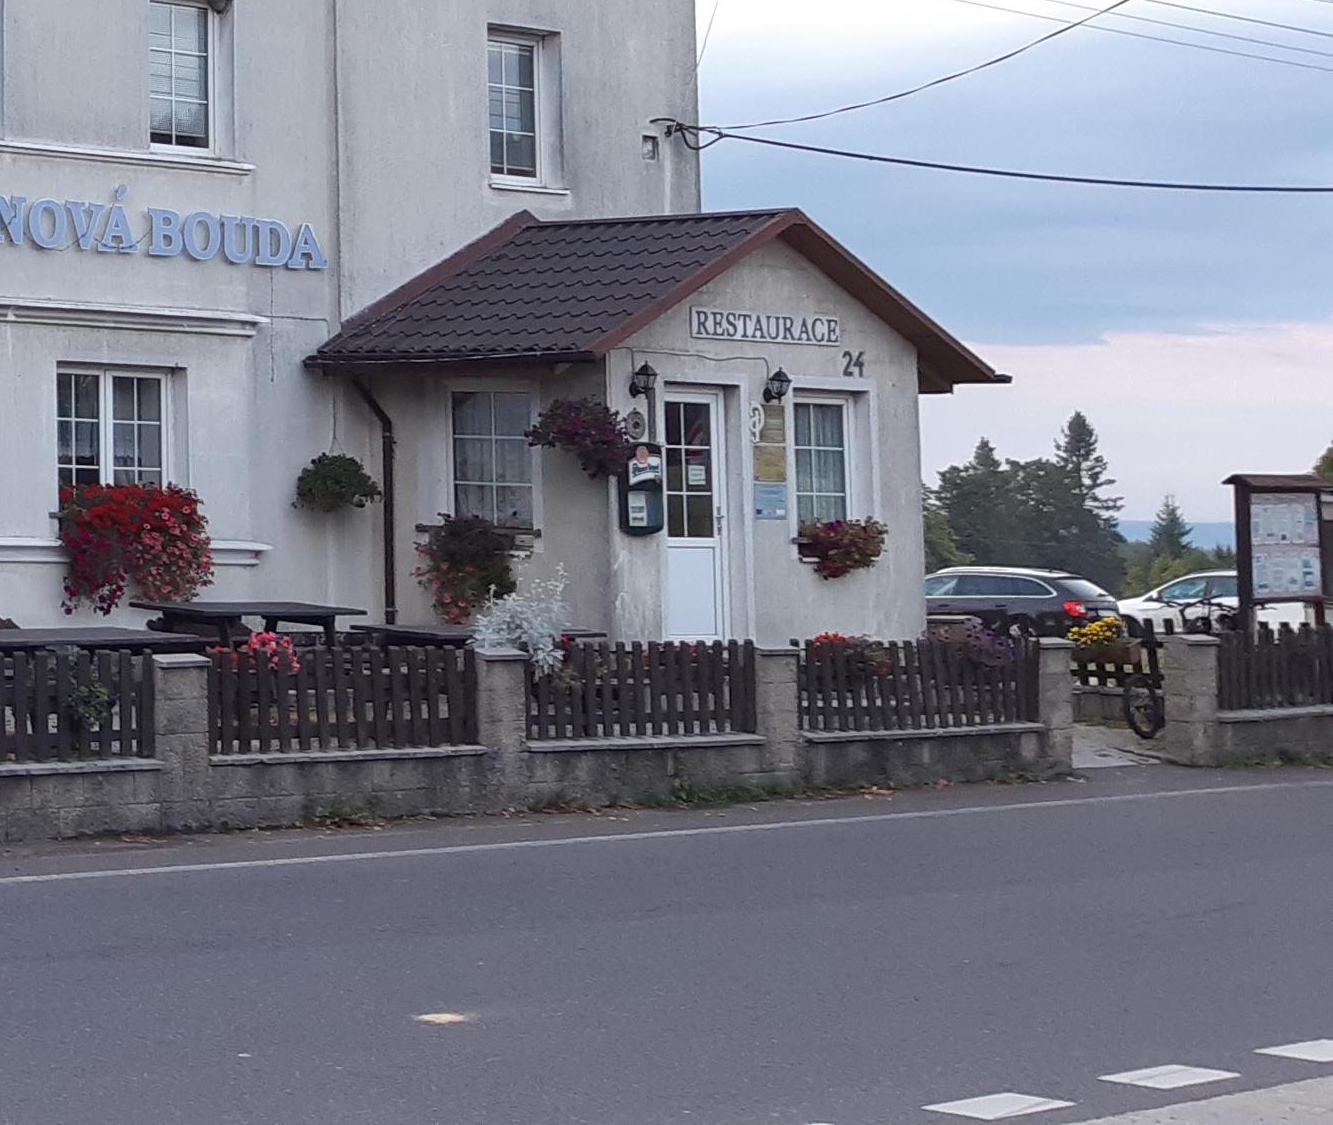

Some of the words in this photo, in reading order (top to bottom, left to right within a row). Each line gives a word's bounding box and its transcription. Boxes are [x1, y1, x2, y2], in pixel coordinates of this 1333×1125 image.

[148, 207, 328, 269] BOUDA
[695, 310, 839, 343] RESTAURACE
[841, 350, 865, 378] 24
